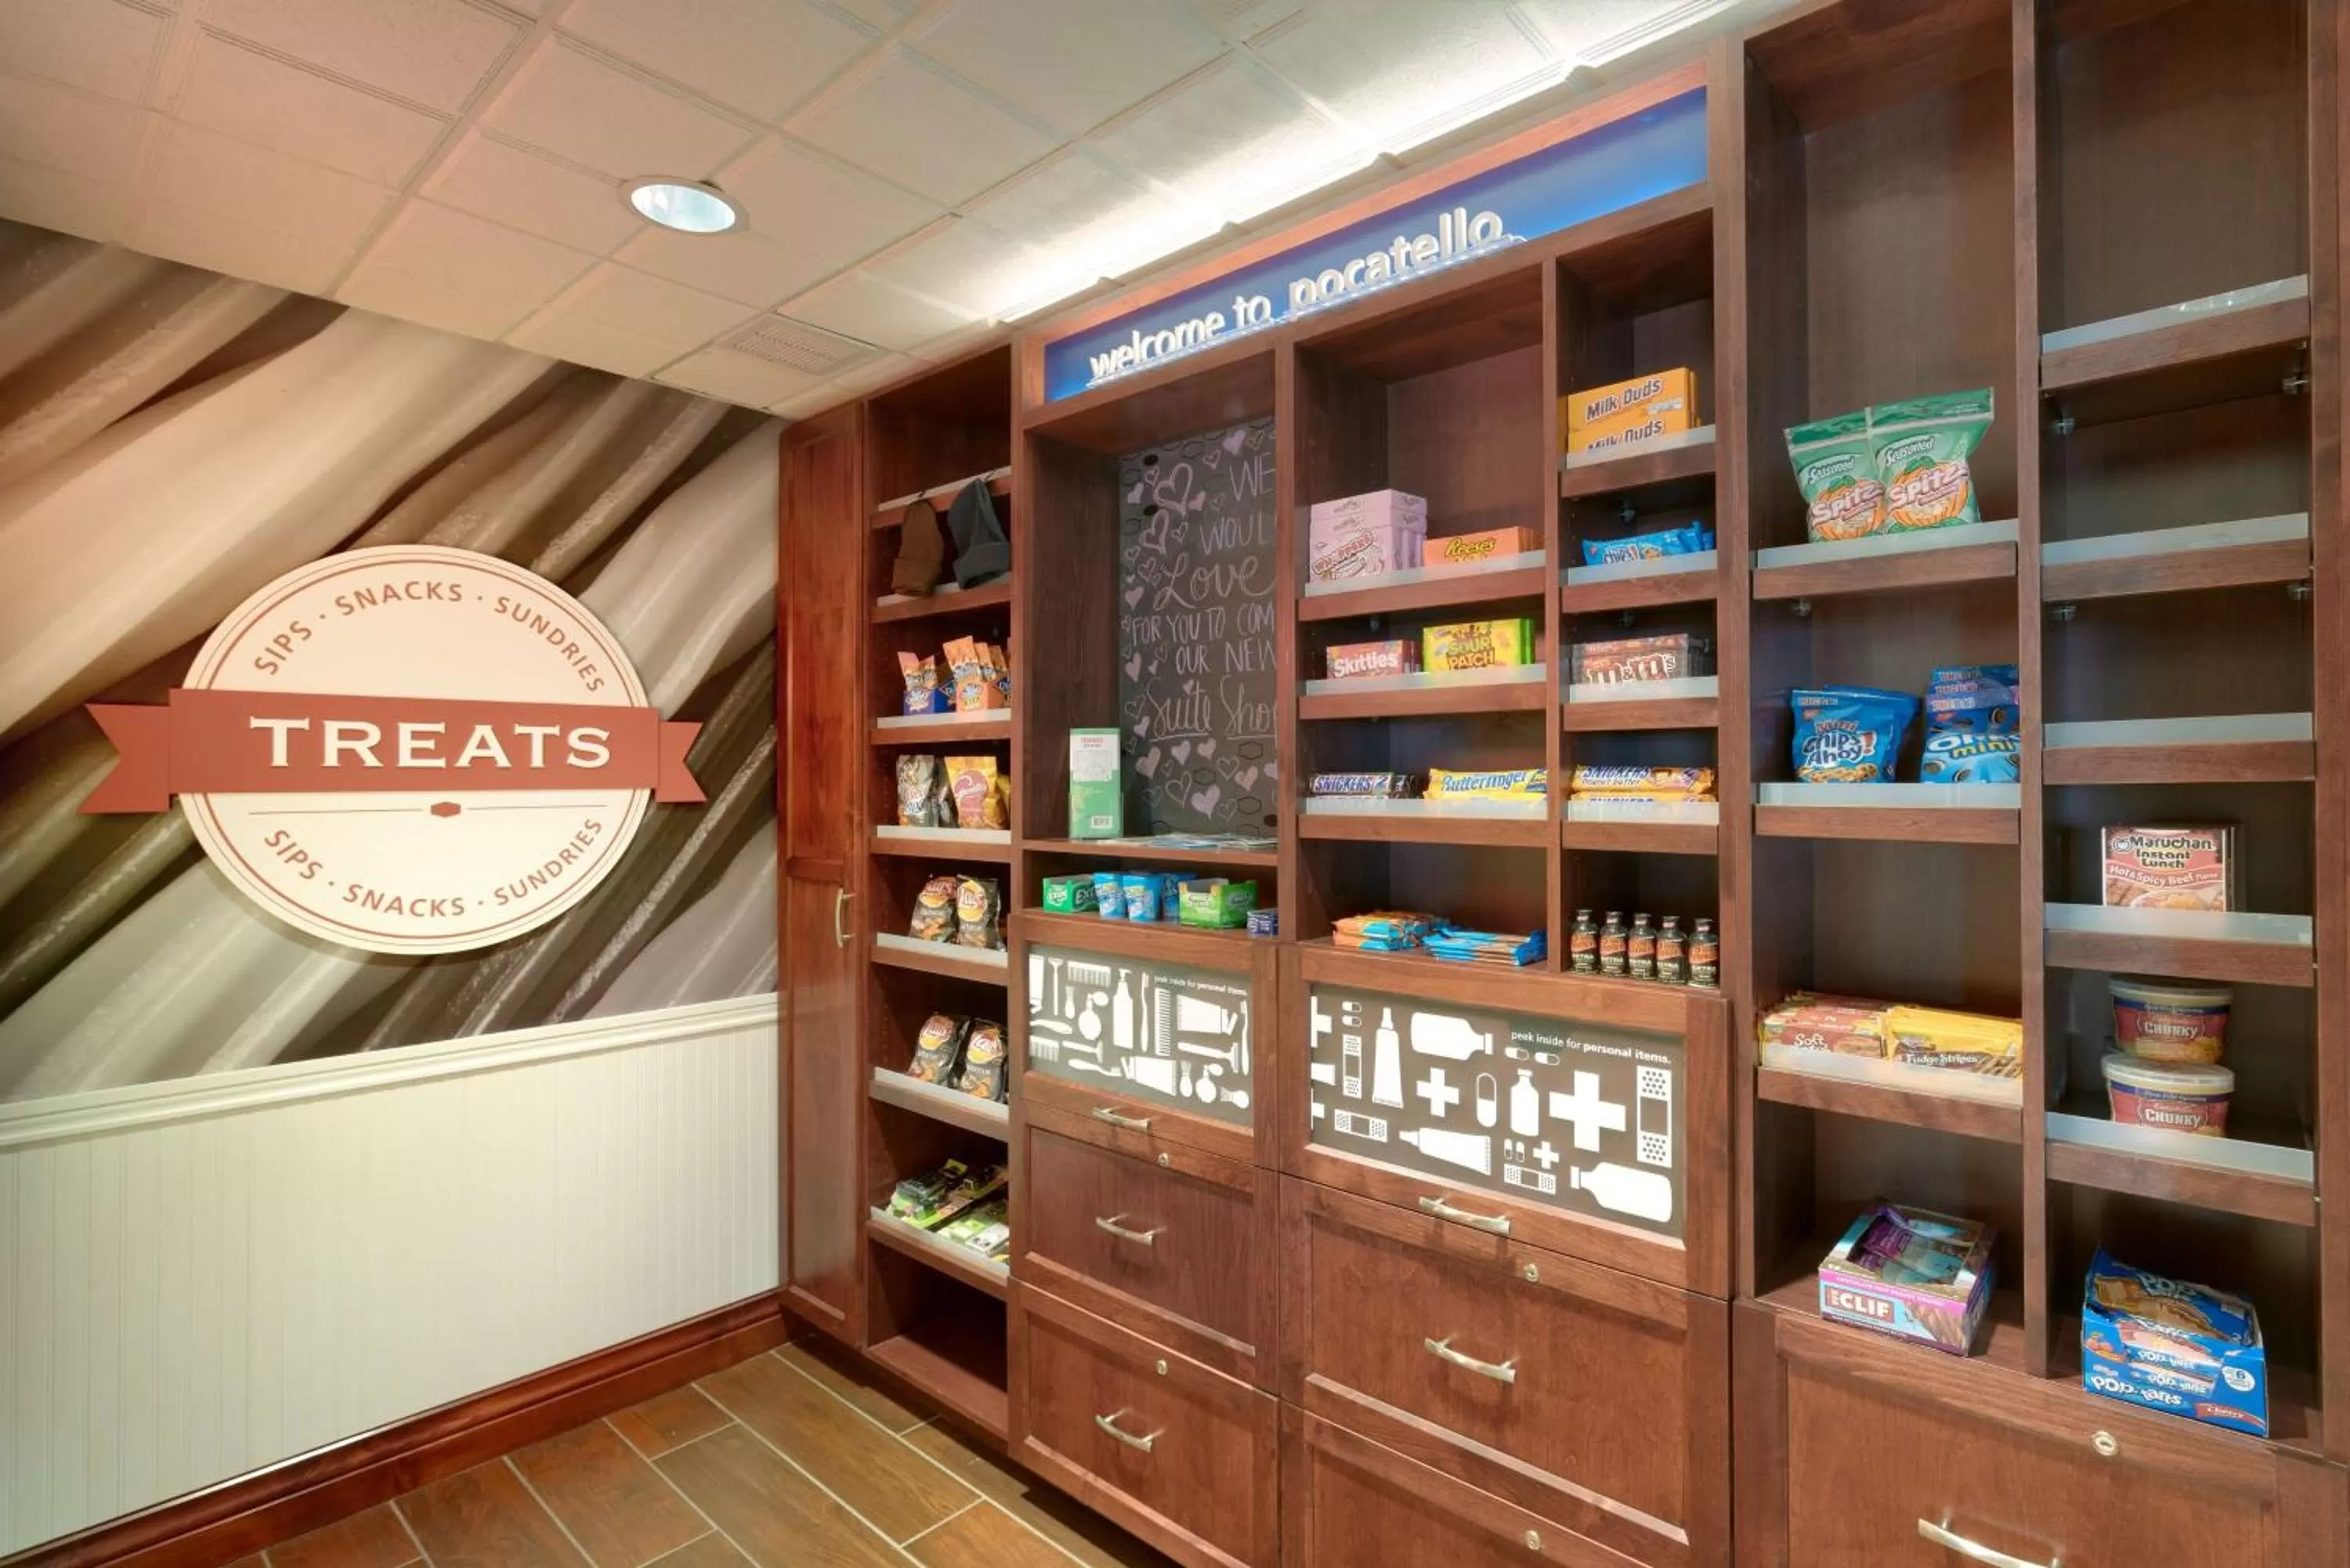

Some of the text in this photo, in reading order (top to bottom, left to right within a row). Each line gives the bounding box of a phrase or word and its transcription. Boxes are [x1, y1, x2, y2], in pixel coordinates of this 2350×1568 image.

[1089, 206, 1504, 381] welcome to pocatello
[1585, 394, 1619, 421] Milk
[1623, 378, 1663, 404] Duds
[1885, 435, 1935, 465] Seasoned
[1228, 452, 1277, 502] WE
[1807, 455, 1856, 485] Seasoned
[1811, 481, 1885, 525] Spitz
[1888, 464, 1969, 511] Spitz
[1199, 510, 1277, 555] WOUL
[1153, 551, 1278, 612] Love
[253, 580, 606, 695] SIPS SNACKS SUNDRIES
[1132, 615, 1162, 647] FOR
[1166, 612, 1201, 644] YOU
[1206, 607, 1226, 640] TO
[1176, 638, 1278, 675] OUR NEW
[1333, 651, 1399, 677] Skittles
[1448, 649, 1495, 670] PATCH
[1146, 675, 1213, 739] Suite
[249, 715, 611, 769] TREATS
[1441, 770, 1526, 793] Butterfinger
[2129, 835, 2212, 850] Maruchan
[2136, 848, 2192, 859] Instant
[263, 817, 602, 919] SIPS SNACKS SUNDRIES
[2142, 858, 2186, 869] Lunch
[2168, 873, 2195, 886] Beef
[1795, 1032, 1826, 1046] Soft
[2143, 1021, 2198, 1039] CHUNKY
[1511, 1031, 1672, 1064] peek inside for personal items.
[2144, 1107, 2201, 1128] CHUNKY
[2207, 1405, 2245, 1419] Cherry
